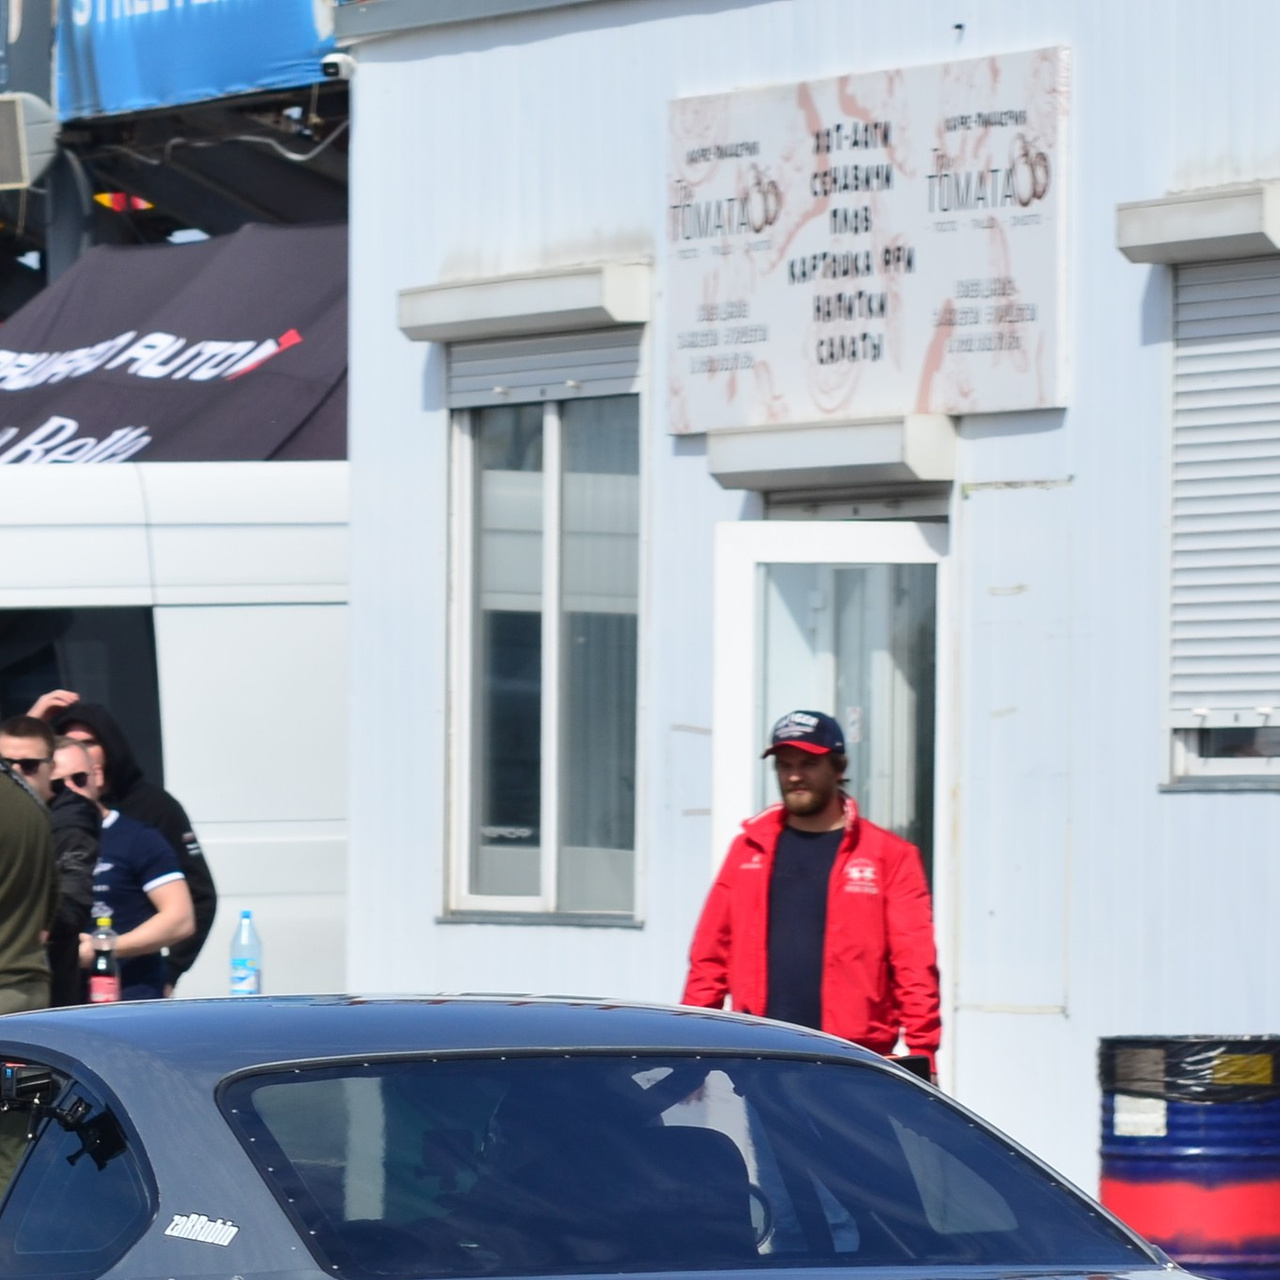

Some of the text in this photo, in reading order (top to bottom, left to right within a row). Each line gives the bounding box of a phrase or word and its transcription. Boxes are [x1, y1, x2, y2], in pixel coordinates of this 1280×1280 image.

[813, 121, 891, 154] ХОТ-ДОГИ
[810, 164, 894, 197] СЕНДВИЧИ
[788, 246, 915, 285] КАРТОШКА ФРИ
[813, 290, 887, 322] НАПИТКИ
[105, 331, 258, 381] AUTO
[817, 332, 884, 365] САЛАТЫ
